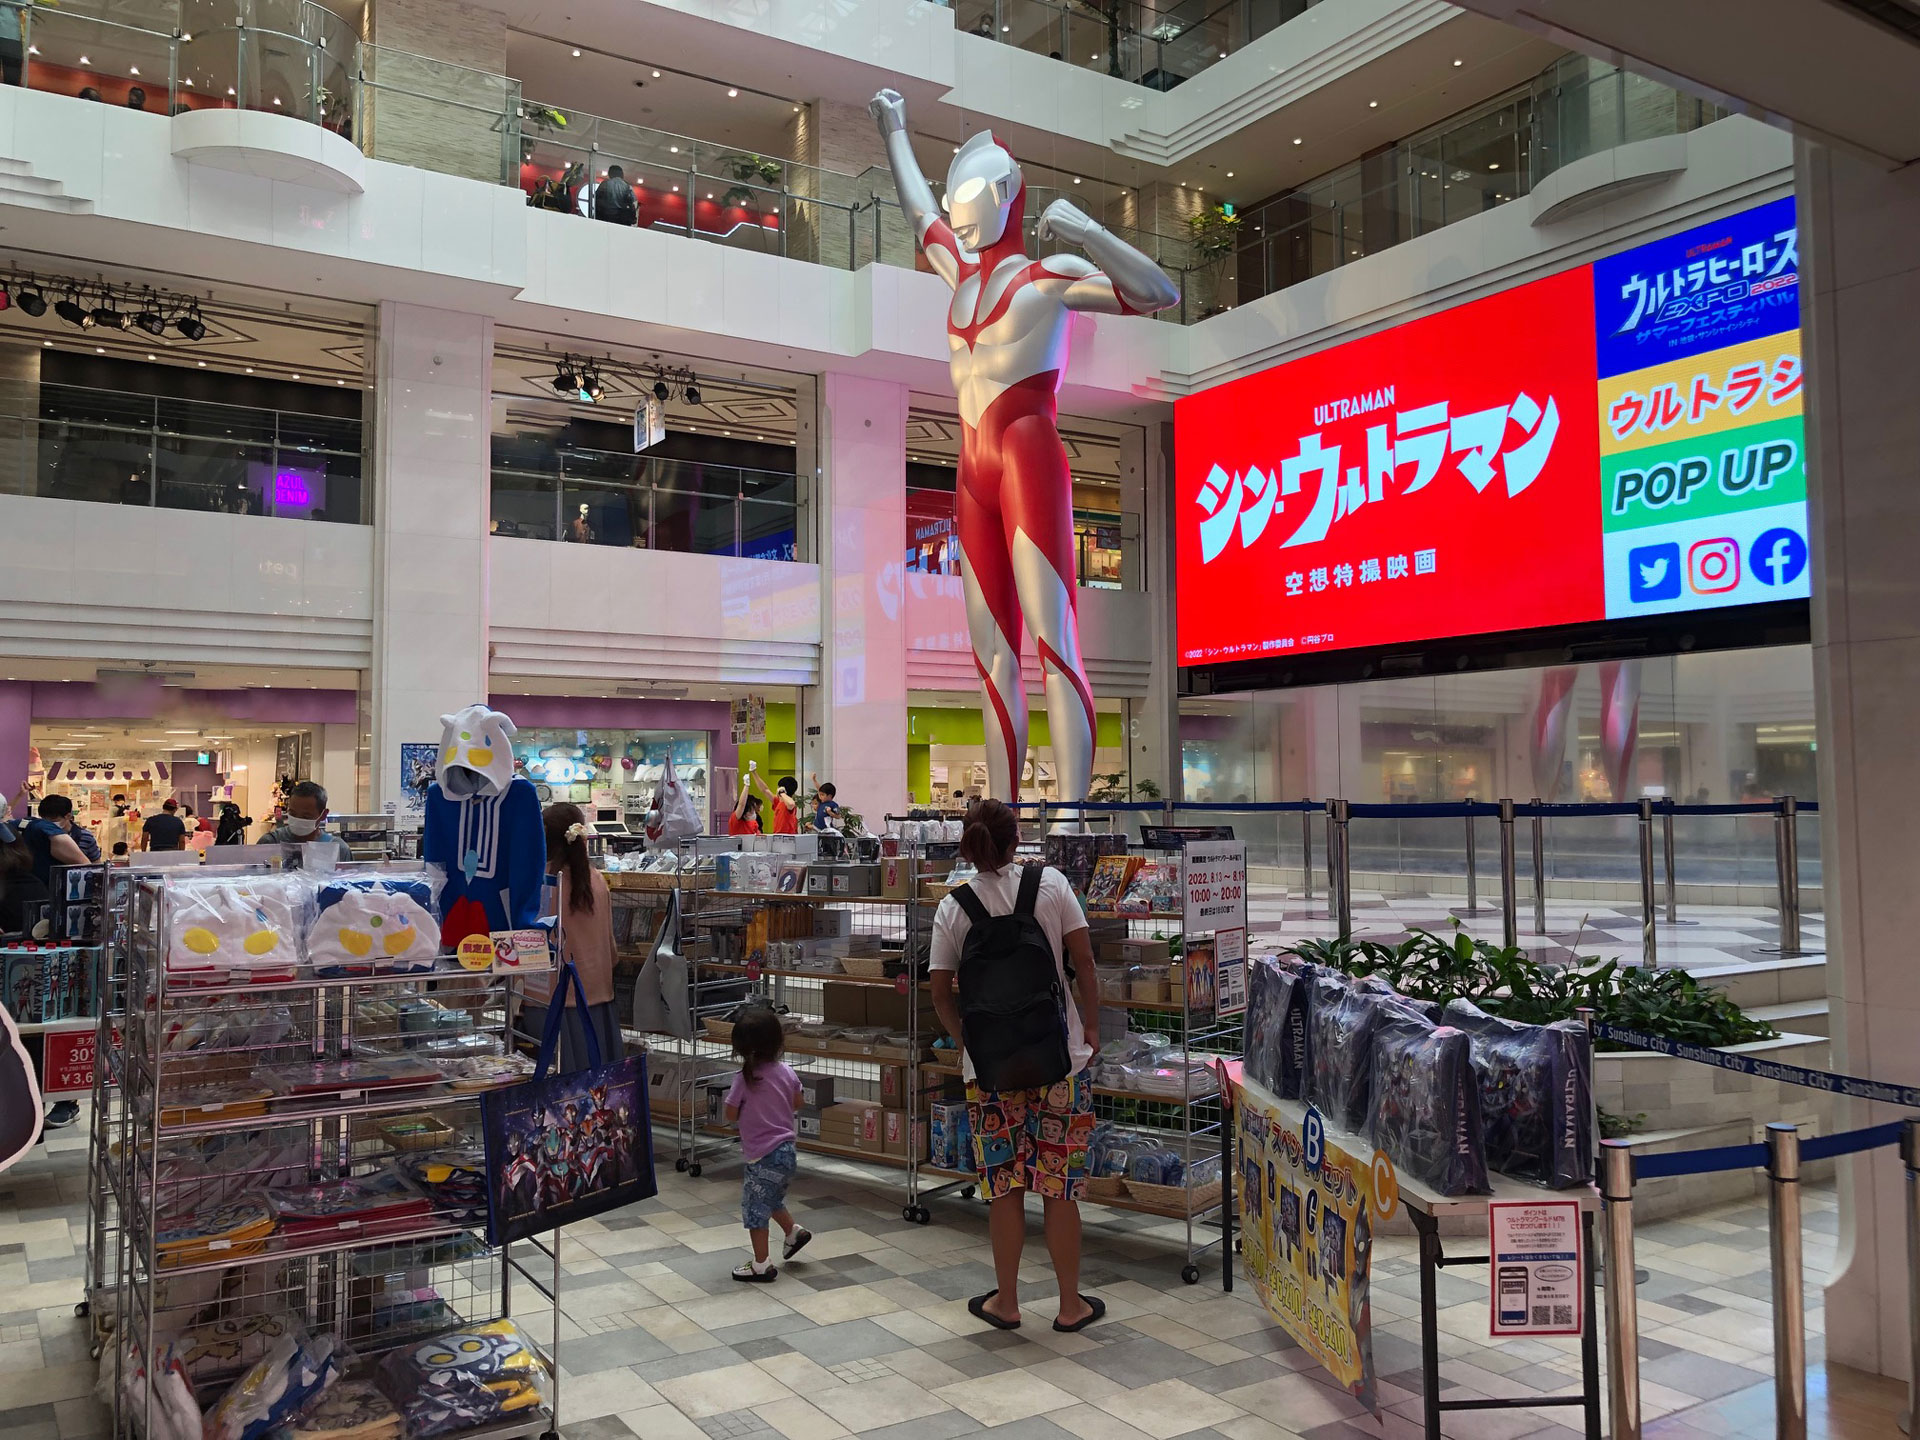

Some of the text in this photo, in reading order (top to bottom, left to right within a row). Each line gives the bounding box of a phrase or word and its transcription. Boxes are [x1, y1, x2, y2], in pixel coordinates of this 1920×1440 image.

[1636, 291, 1795, 345] サマーフェスティバル
[1655, 272, 1799, 323] EXPO 2022
[1313, 384, 1395, 426] ULTRAMAN
[1195, 391, 1561, 565] シン・ウルトラマン
[1614, 441, 1794, 513] POP UP
[1285, 548, 1437, 596] 空想特撮映画
[79, 760, 116, 770] Sanrio
[1190, 888, 1211, 903] 10:00
[1221, 885, 1242, 900] 20:00
[1290, 1008, 1305, 1070] ULTRAMAN
[1607, 1026, 1670, 1053] Sunshine City
[1676, 1043, 1747, 1072] Sunshine City
[1753, 1061, 1834, 1091] Sunshine City
[1841, 1078, 1900, 1102] Sunshine
[1564, 1068, 1577, 1149] ULTRAMAN
[1306, 1115, 1321, 1165] B
[1267, 1160, 1276, 1204] B
[1375, 1157, 1390, 1212] C
[1306, 1188, 1318, 1235] C
